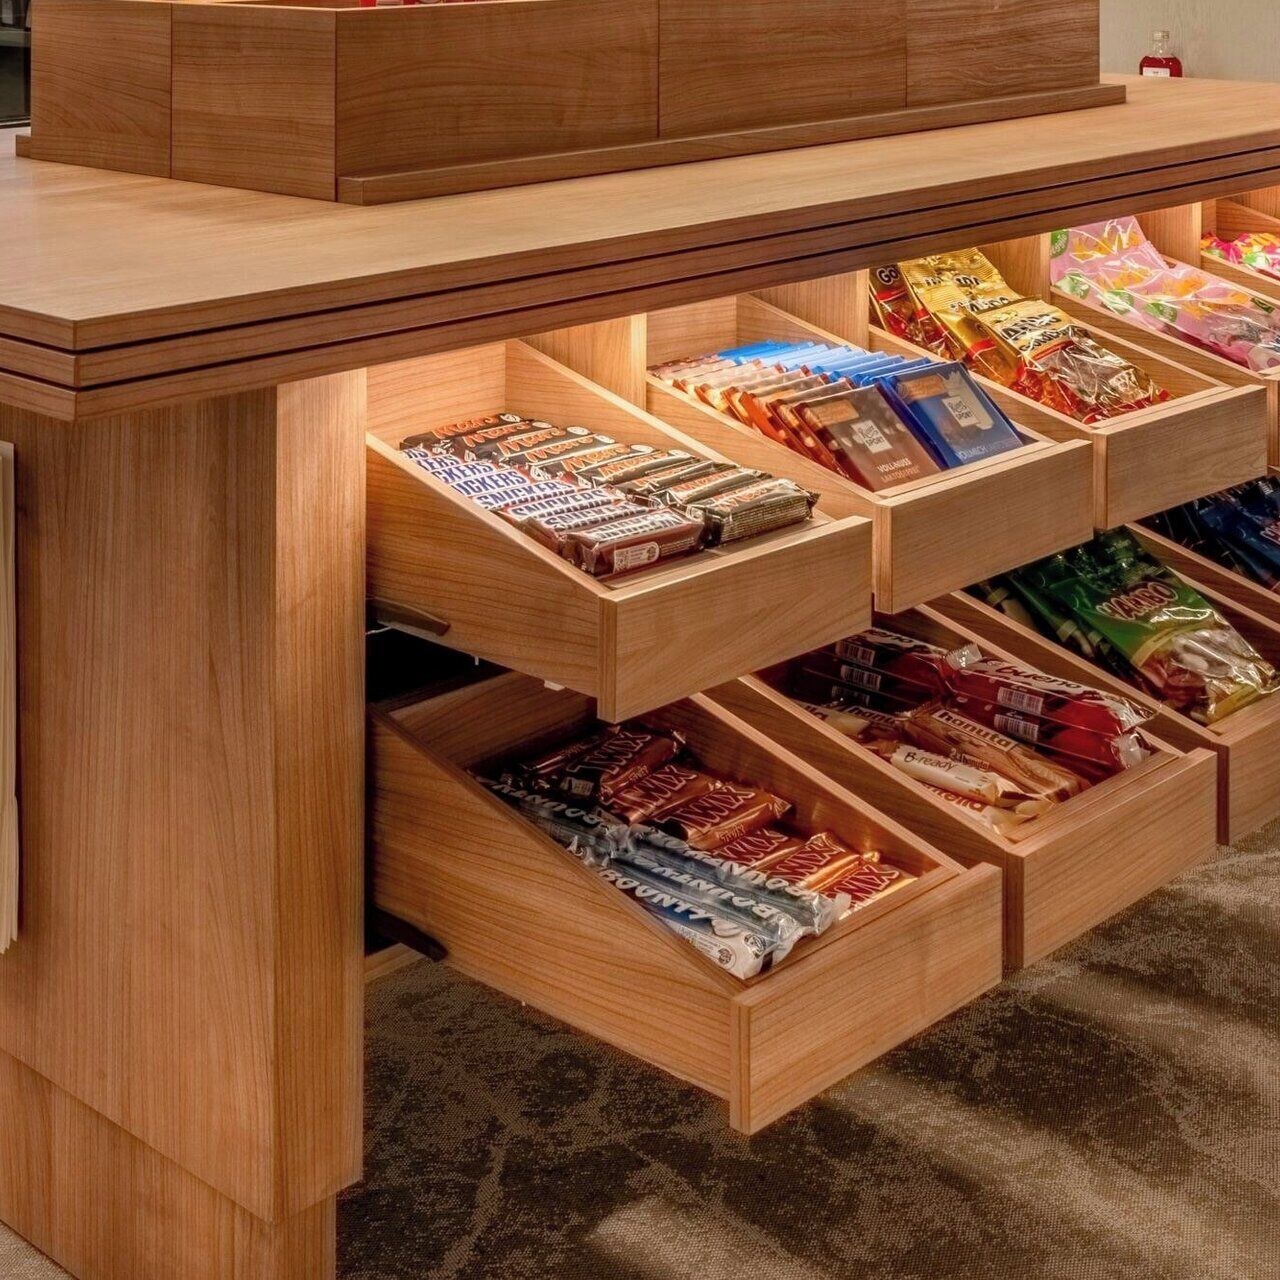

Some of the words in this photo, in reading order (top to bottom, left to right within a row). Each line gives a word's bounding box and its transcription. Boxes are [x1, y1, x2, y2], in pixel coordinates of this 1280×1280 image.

[431, 414, 499, 439] Mars
[462, 421, 531, 448] Mars
[497, 427, 567, 455] Mars
[525, 436, 594, 463] Mars
[561, 444, 632, 472] Mars
[475, 479, 574, 510] SNICKERS
[1095, 581, 1179, 621] HARIBO
[996, 664, 1082, 690] bueno
[937, 708, 1014, 749] hanuta
[566, 731, 652, 776] TWIX
[903, 750, 957, 772] B-ready
[602, 765, 698, 817] TWIX
[654, 786, 756, 831] TWIX
[598, 869, 716, 920] BOUNTY
